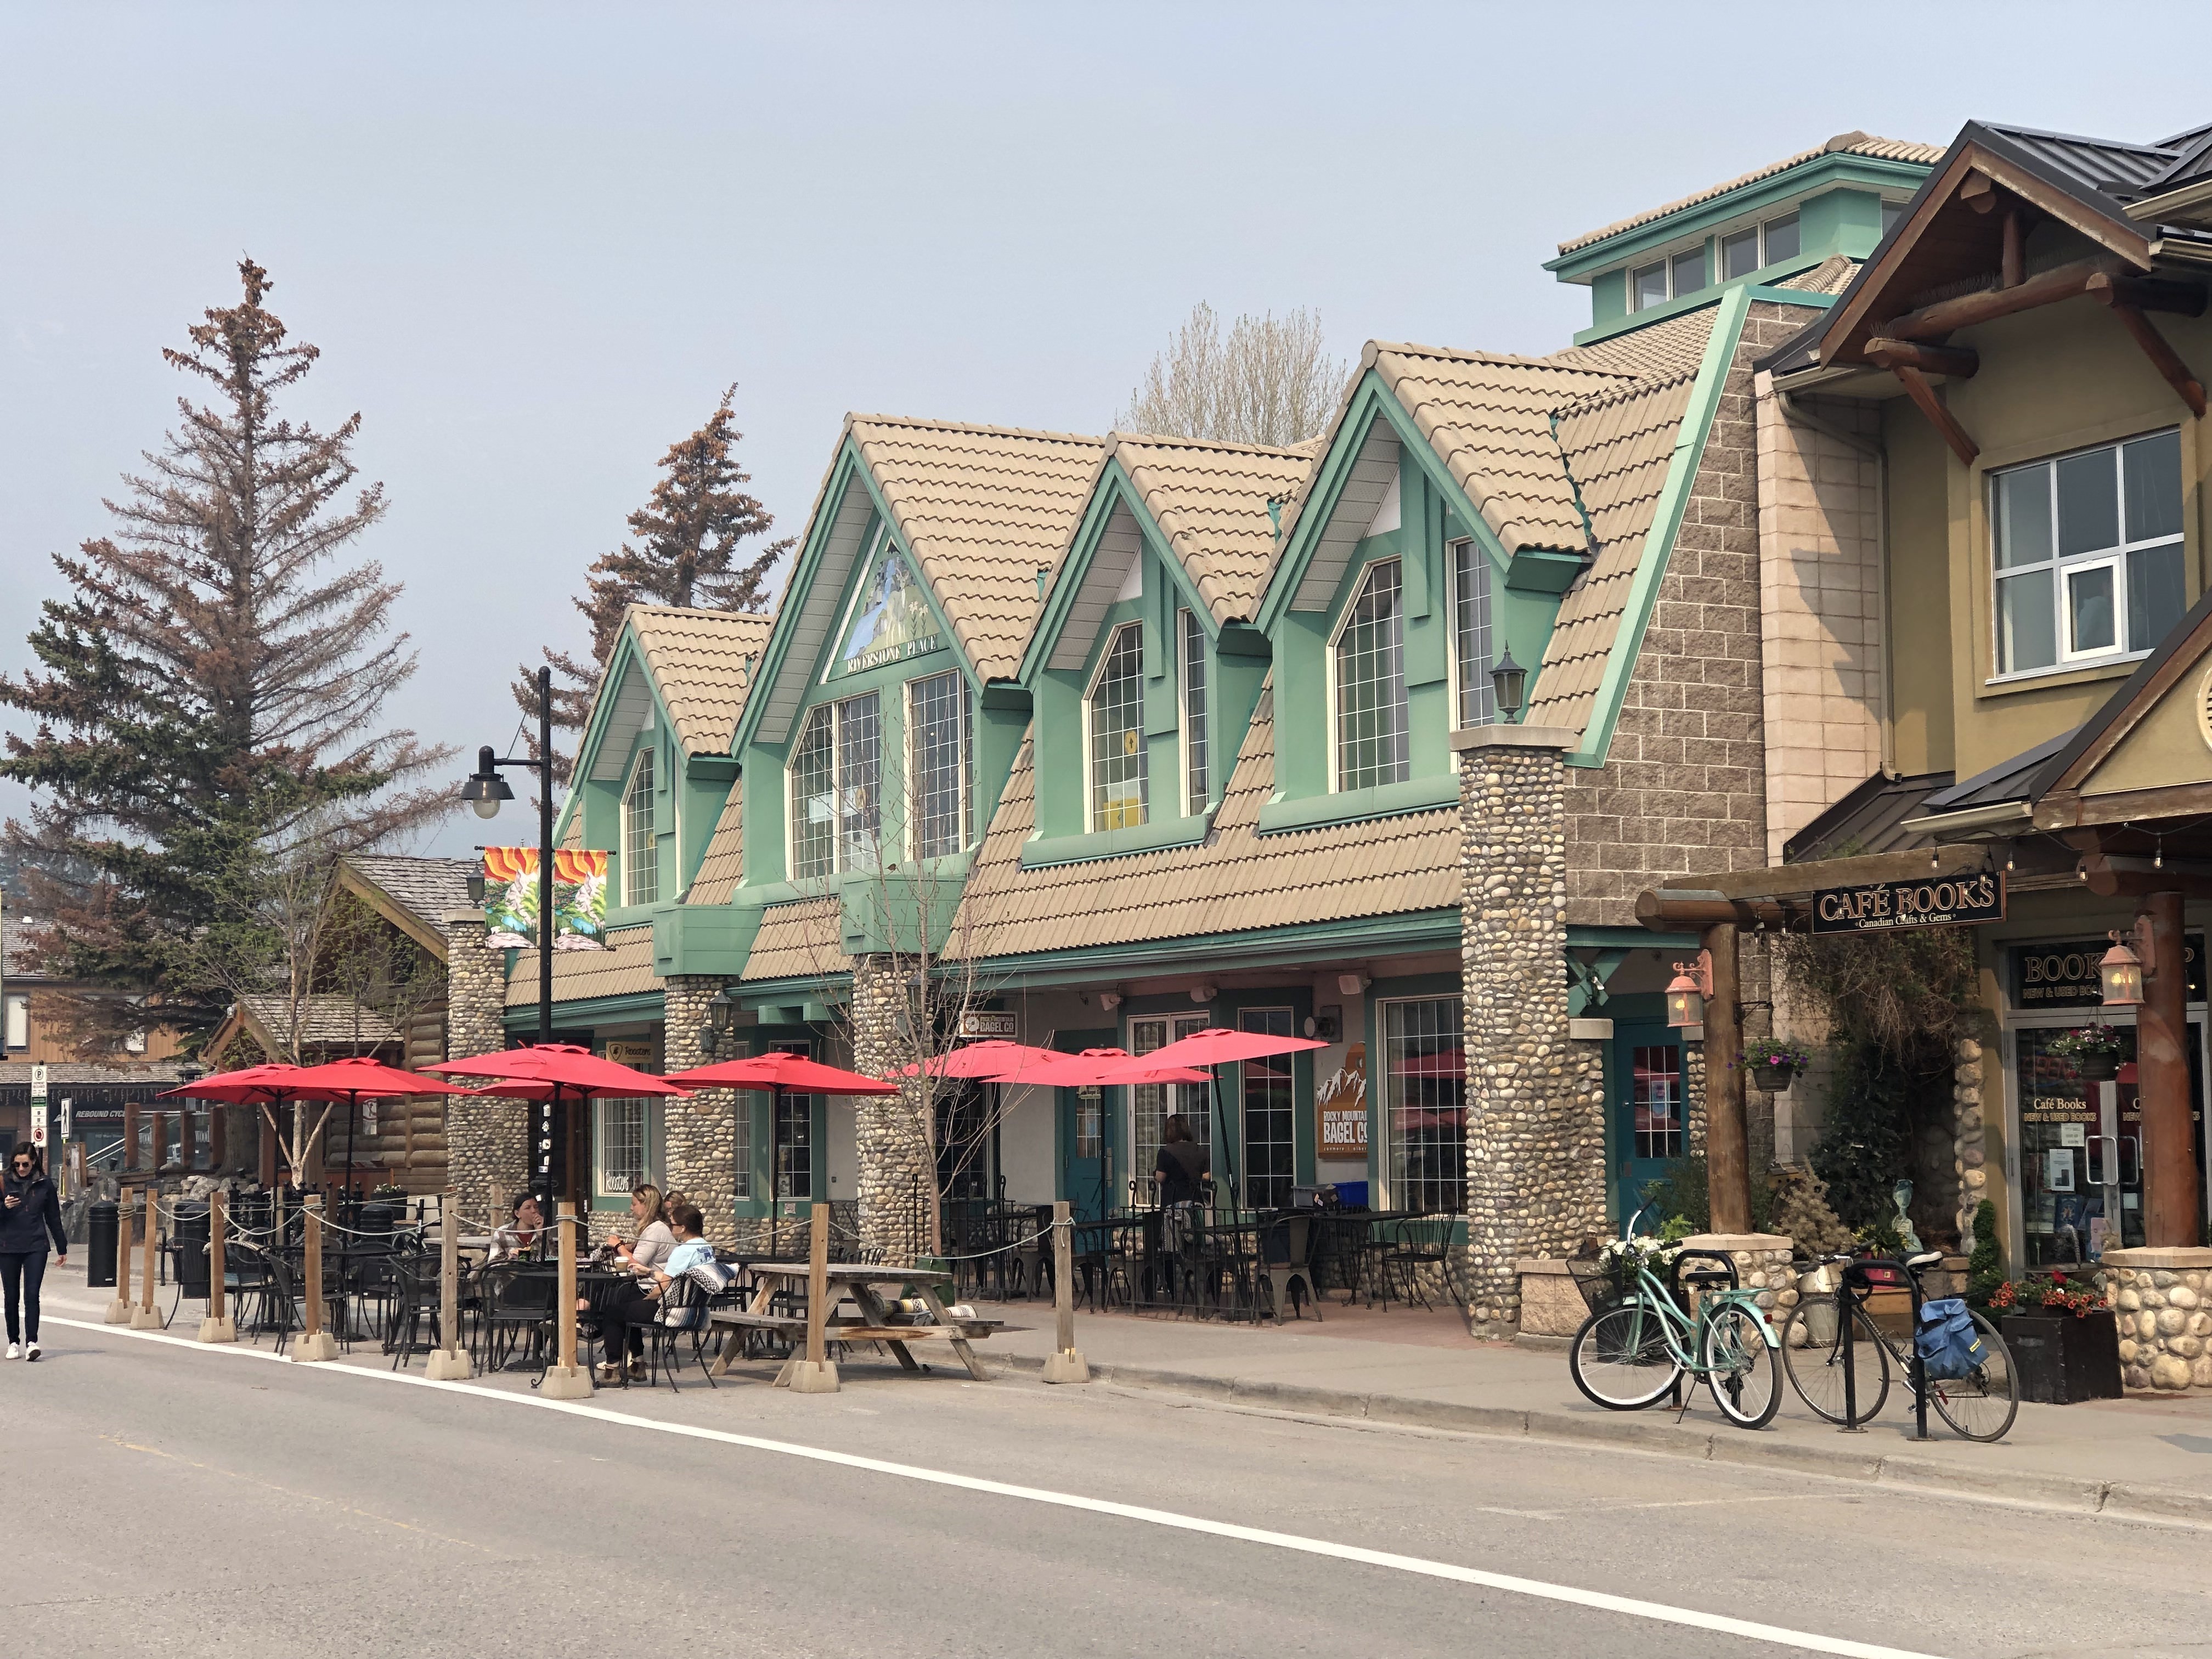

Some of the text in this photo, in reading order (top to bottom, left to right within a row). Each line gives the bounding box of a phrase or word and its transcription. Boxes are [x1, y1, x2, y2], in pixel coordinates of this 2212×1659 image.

[847, 635, 936, 674] RIVERSTONE PLACE
[1820, 878, 1995, 921] CAFÉ BOOKS
[1859, 918, 1894, 928] Canadian
[1929, 913, 1951, 922] Gems
[2023, 988, 2044, 998] NEW
[2046, 987, 2053, 998] &
[2055, 986, 2078, 997] USED
[980, 1022, 1003, 1032] BAGEL
[2034, 1098, 2086, 1110] Café Books
[1323, 1110, 1341, 1121] ROCKY
[2024, 1112, 2097, 1122] NEW & USED BOOKS
[1323, 1121, 1356, 1144] BAGEL
[605, 1171, 629, 1192] Roosters
